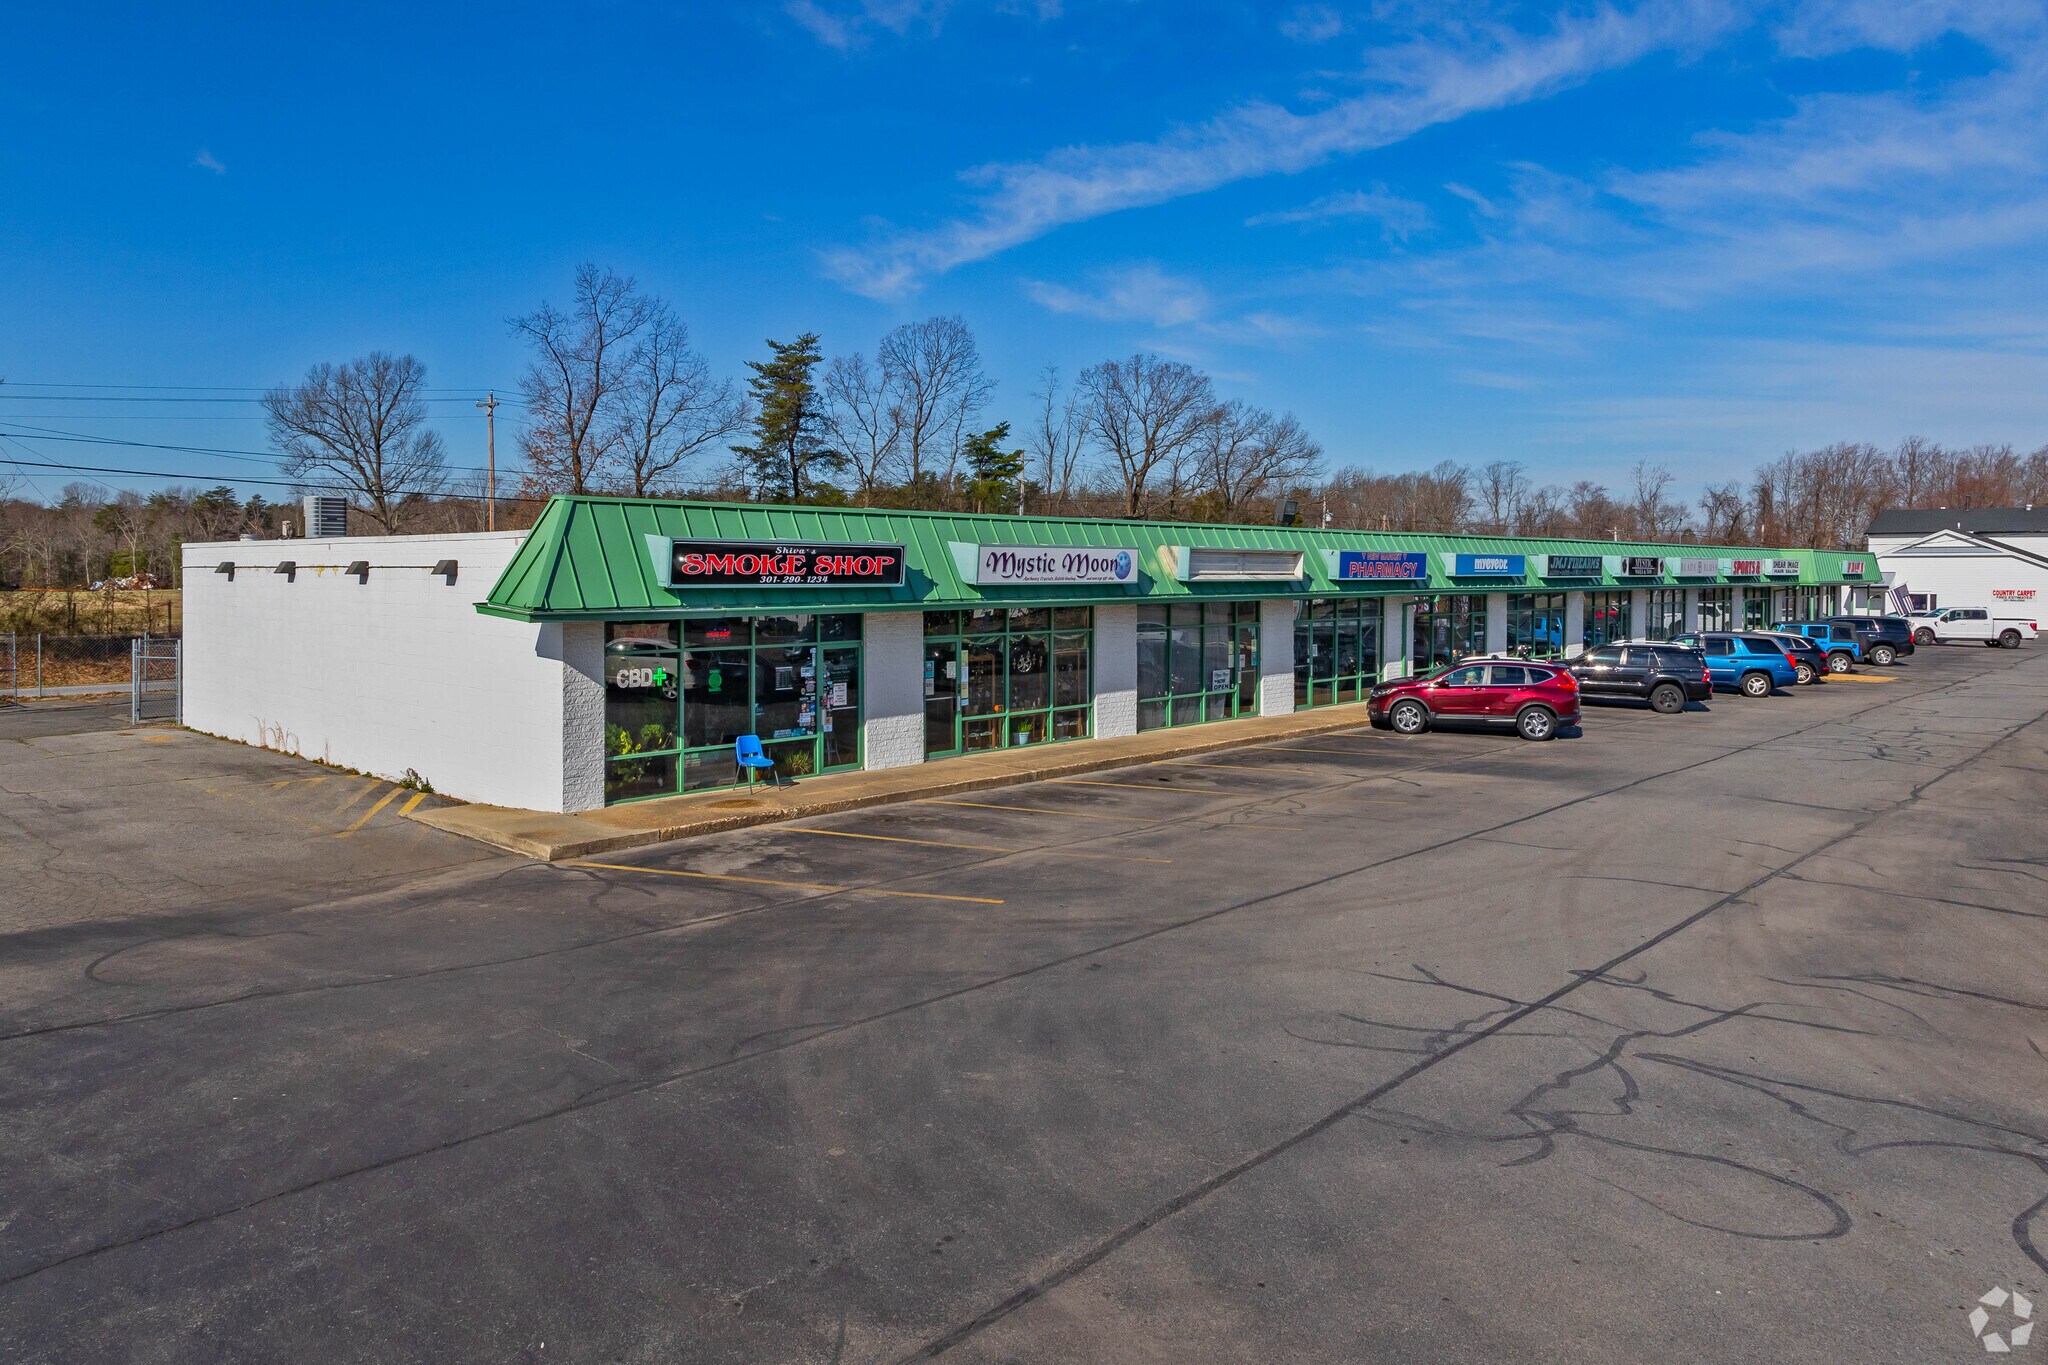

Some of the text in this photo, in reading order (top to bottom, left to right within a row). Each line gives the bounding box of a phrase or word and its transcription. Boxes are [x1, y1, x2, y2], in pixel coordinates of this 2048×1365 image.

[775, 546, 817, 554] Shiva's
[681, 554, 895, 575] SMOKE SHOP
[986, 551, 1118, 578] Mystic Moon
[1349, 561, 1418, 578] PHARMACY
[1550, 557, 1601, 569] JMJ FIREARMS
[1733, 561, 1755, 575] SPORTS
